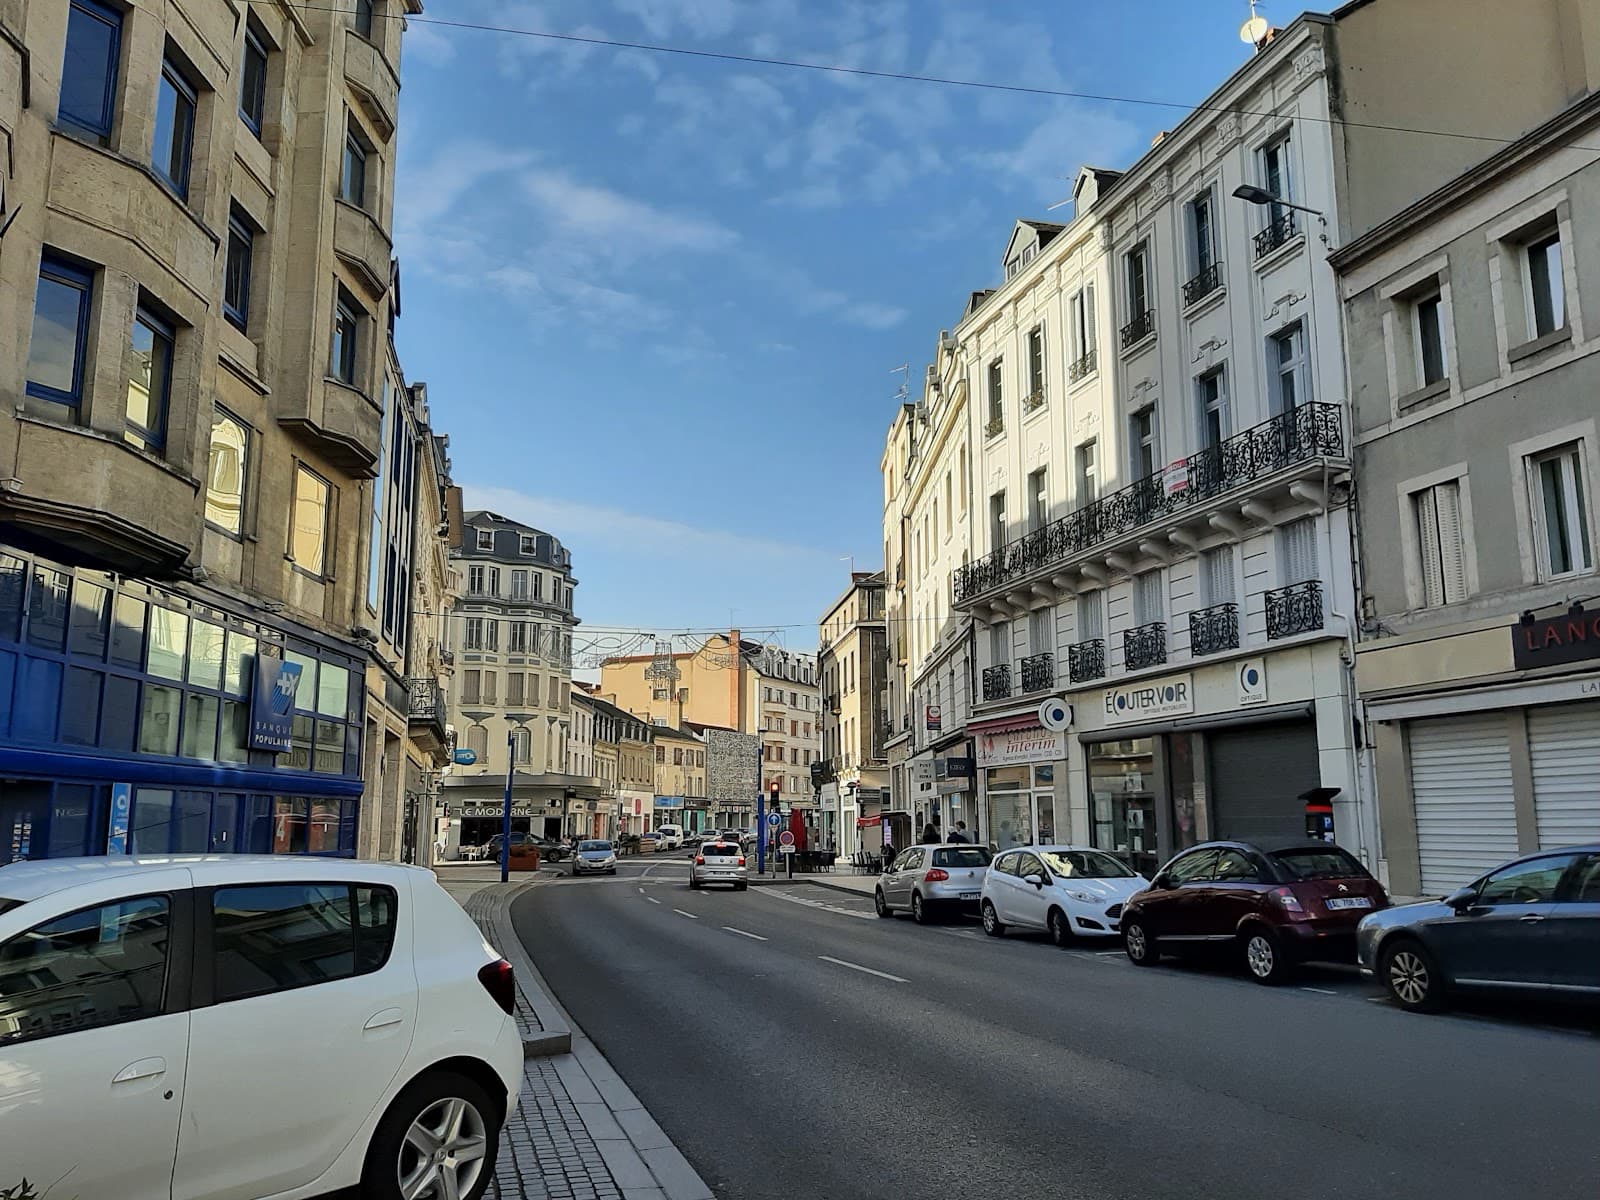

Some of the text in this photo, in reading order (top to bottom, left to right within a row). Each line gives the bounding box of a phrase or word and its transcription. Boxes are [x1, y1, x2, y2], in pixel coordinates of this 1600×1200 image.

[1581, 682, 1600, 694] LA
[255, 734, 292, 748] POPULAIRE
[1006, 739, 1056, 754] interim
[474, 807, 539, 817] MODRNE
[1323, 816, 1332, 829] P
